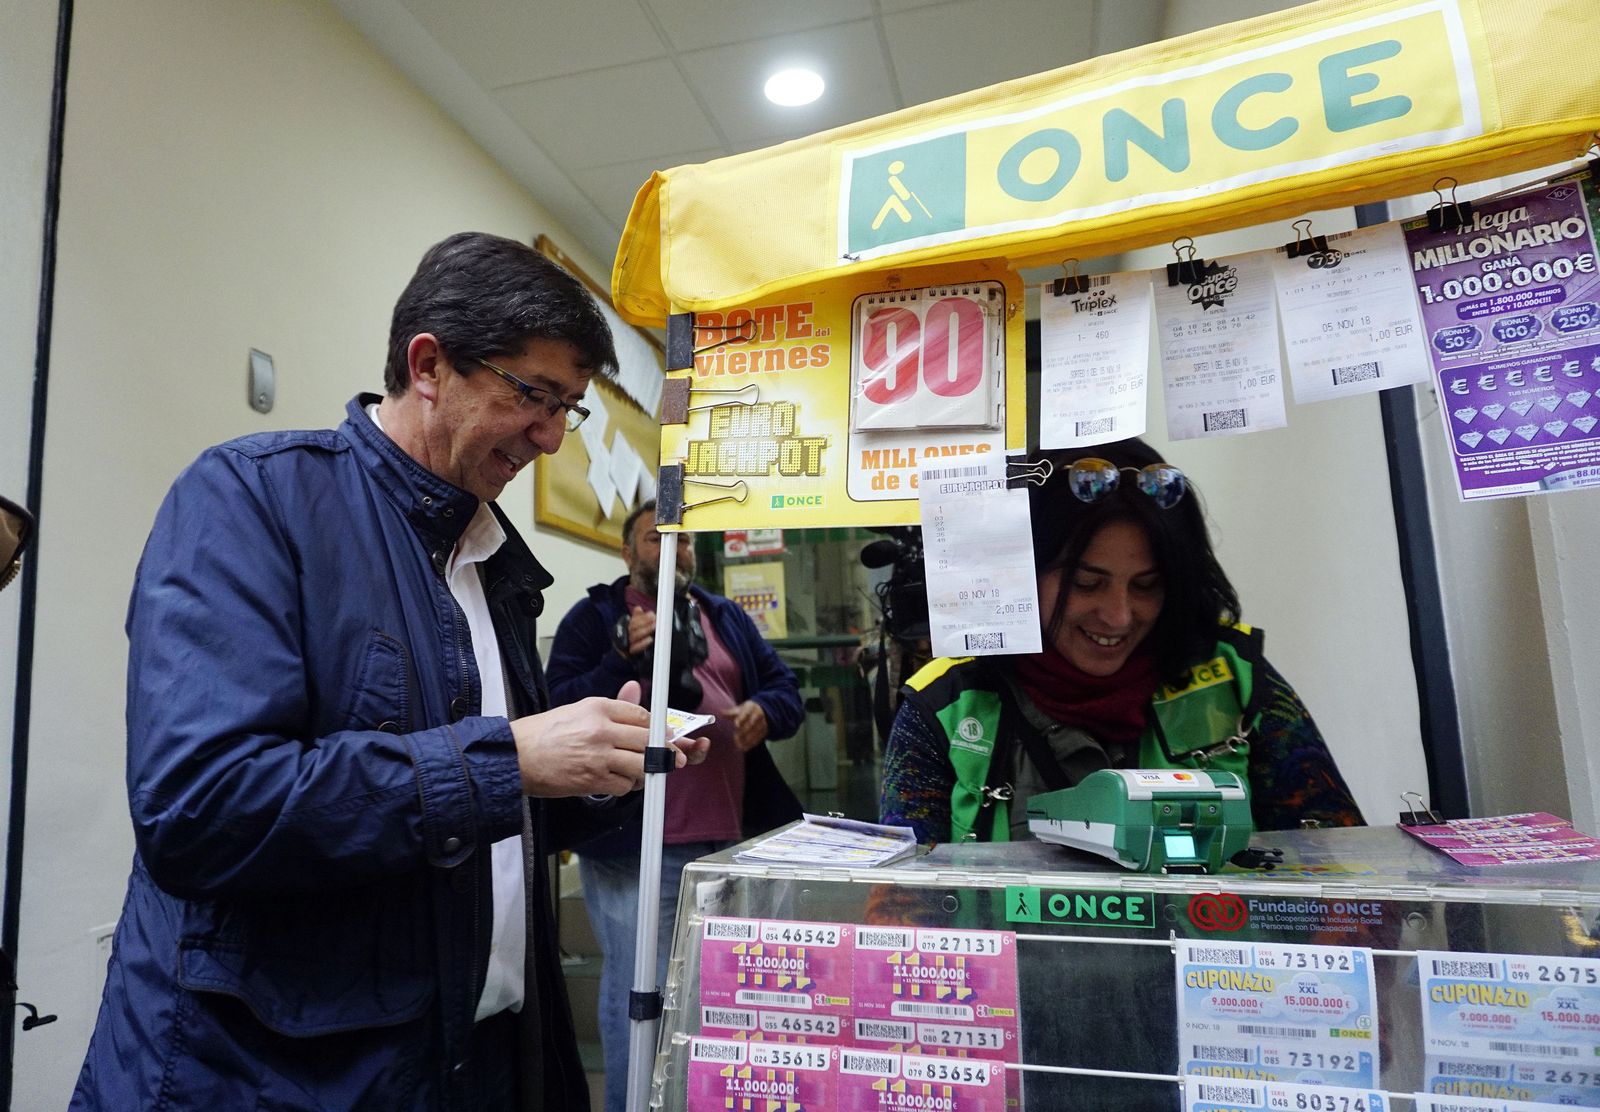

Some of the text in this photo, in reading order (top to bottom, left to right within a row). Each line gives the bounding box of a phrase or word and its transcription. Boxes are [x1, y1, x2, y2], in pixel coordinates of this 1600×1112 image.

[997, 39, 1412, 202] ONCE
[1414, 217, 1586, 272] MILLONARIO
[1482, 256, 1522, 272] GANA
[1420, 253, 1596, 305] 1.000.000€
[1561, 303, 1590, 316] BONUS
[695, 302, 830, 348] BOTE del
[1322, 316, 1371, 333] 05 NOV 18
[1501, 316, 1530, 328] BONUS
[1369, 329, 1390, 343] 1,00
[1395, 324, 1413, 337] EUR
[1442, 327, 1470, 338] BONUS
[863, 297, 984, 404] 90
[694, 344, 830, 378] viernes
[1261, 374, 1276, 386] EUR
[711, 402, 795, 439] EURO
[684, 438, 826, 475] JACKPOT
[871, 471, 899, 490] de
[787, 496, 822, 506] ONCE
[959, 588, 1000, 600] 09 NOV 18
[996, 604, 1015, 615] 2,00
[1018, 603, 1033, 613] EUR
[1048, 893, 1145, 922] ONCE
[1249, 899, 1382, 916] Fundación ONCE
[1261, 923, 1294, 931] Personas
[1310, 923, 1358, 933] Discapacidad
[1275, 914, 1319, 924] Cooperación
[1327, 916, 1359, 924] Inclusión
[1360, 917, 1382, 925] Social
[766, 928, 836, 945] 054 46542
[922, 936, 995, 953] 079 27131
[1259, 952, 1350, 971] 084 73192
[1186, 969, 1275, 992] CUPONAZO
[1512, 965, 1597, 984] 099 2675
[1299, 985, 1319, 994] XXL
[1431, 983, 1531, 1008] CUPONAZO
[1212, 997, 1258, 1008] 9.000.000
[1284, 995, 1343, 1009] 15.000.000
[1557, 1001, 1579, 1010] XXL
[781, 1017, 836, 1034] 46542
[1459, 1012, 1512, 1024] 9.000.000
[1212, 1023, 1220, 1031] 18
[1341, 1029, 1371, 1039] ONCE
[941, 1030, 998, 1047] 27131
[1461, 1040, 1470, 1048] 18
[754, 1050, 826, 1067] 024 35615
[1264, 1051, 1355, 1071] 085 73192
[908, 1064, 986, 1083] 079 83654
[1272, 1092, 1366, 1112] 048 80374
